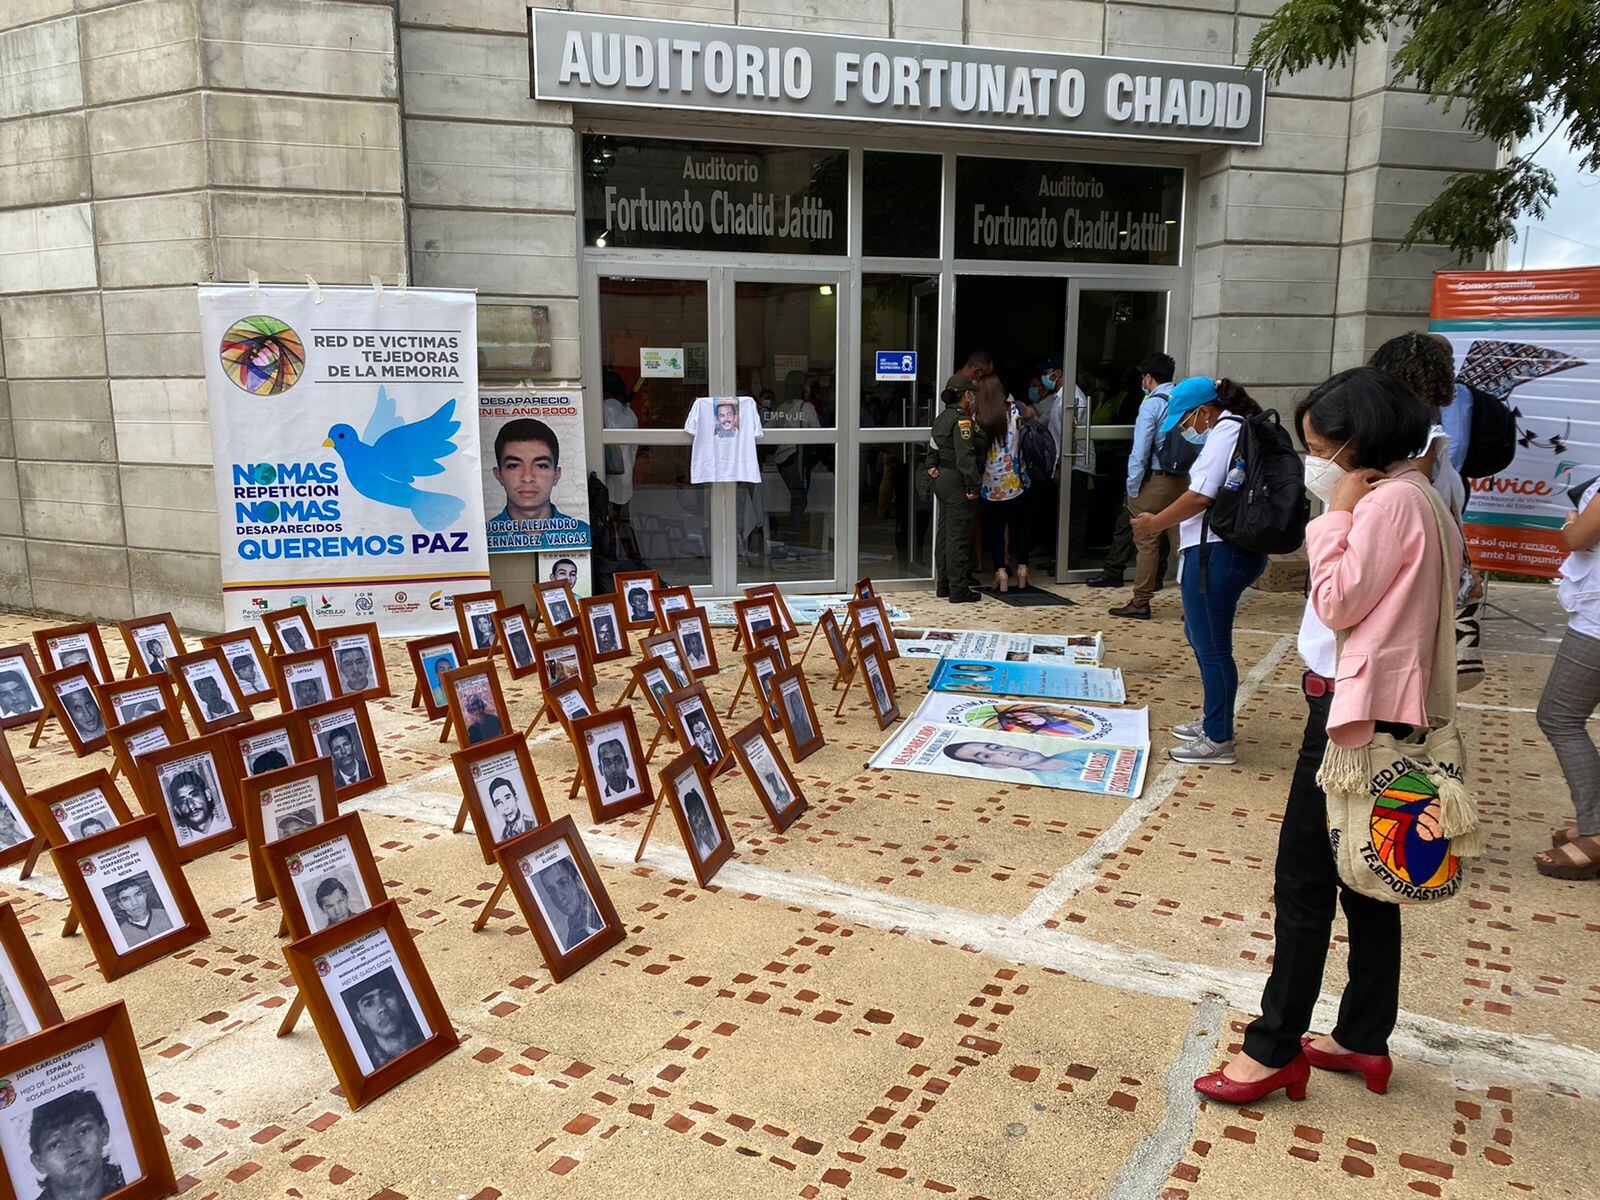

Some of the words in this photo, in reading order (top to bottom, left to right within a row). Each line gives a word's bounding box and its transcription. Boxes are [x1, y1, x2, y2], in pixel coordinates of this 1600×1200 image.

[558, 30, 812, 101] AUDITORIO
[834, 51, 1085, 118] FORTUNATO
[1106, 72, 1252, 130] CHADID
[682, 154, 759, 184] Auditorio
[1038, 173, 1105, 200] Auditorio
[604, 185, 705, 234] Fortunato
[710, 190, 775, 237] Chadid
[777, 193, 834, 241] Jattin
[972, 203, 1057, 249] Fortunato
[1062, 206, 1119, 252] Chadid
[1120, 210, 1169, 252] Jattin
[1458, 281, 1492, 290] Somos
[1495, 280, 1536, 289] semilla,
[1527, 292, 1580, 302] memoria
[314, 336, 348, 348] RED
[353, 336, 376, 348] DE
[380, 336, 458, 348] VICTIMAS
[362, 351, 460, 363] TEJEDORAS
[328, 366, 350, 377] DE
[355, 366, 378, 377] LA
[382, 366, 460, 378] MEMORIA
[480, 396, 570, 406] DESAPARECIO
[478, 408, 493, 416] EN
[494, 408, 510, 416] EL
[512, 406, 542, 416] AÑO
[542, 407, 578, 416] 2000
[764, 411, 806, 421] EMPUJE
[234, 484, 339, 499] REPETICION
[236, 524, 342, 536] DESAPARECIDOS
[521, 518, 579, 532] ALEJANDRO
[238, 534, 405, 560] QUEREMOS
[412, 532, 470, 554] PAZ
[488, 532, 542, 548] ERNÁNDEZ
[546, 532, 588, 545] VARGAS
[1481, 538, 1496, 546] sol
[1498, 540, 1518, 550] que
[1520, 542, 1560, 553] renace,
[1480, 550, 1504, 560] ante
[1506, 551, 1516, 560] la
[890, 726, 937, 766] DESAPARECIDO
[118, 868, 132, 876] NEIVA
[341, 978, 352, 986] HIJO
[376, 956, 392, 968] GOMEZ
[16, 1068, 34, 1080] JUAN
[36, 1056, 62, 1072] CARLOS
[63, 1042, 96, 1060] ESPINOSA
[46, 1061, 72, 1076] ESPAÑA
[20, 1086, 36, 1096] HIJO
[50, 1070, 72, 1083] MARIA
[72, 1063, 86, 1072] DEL
[26, 1085, 56, 1104] ROSARIO
[56, 1072, 86, 1090] ALVAREZ
